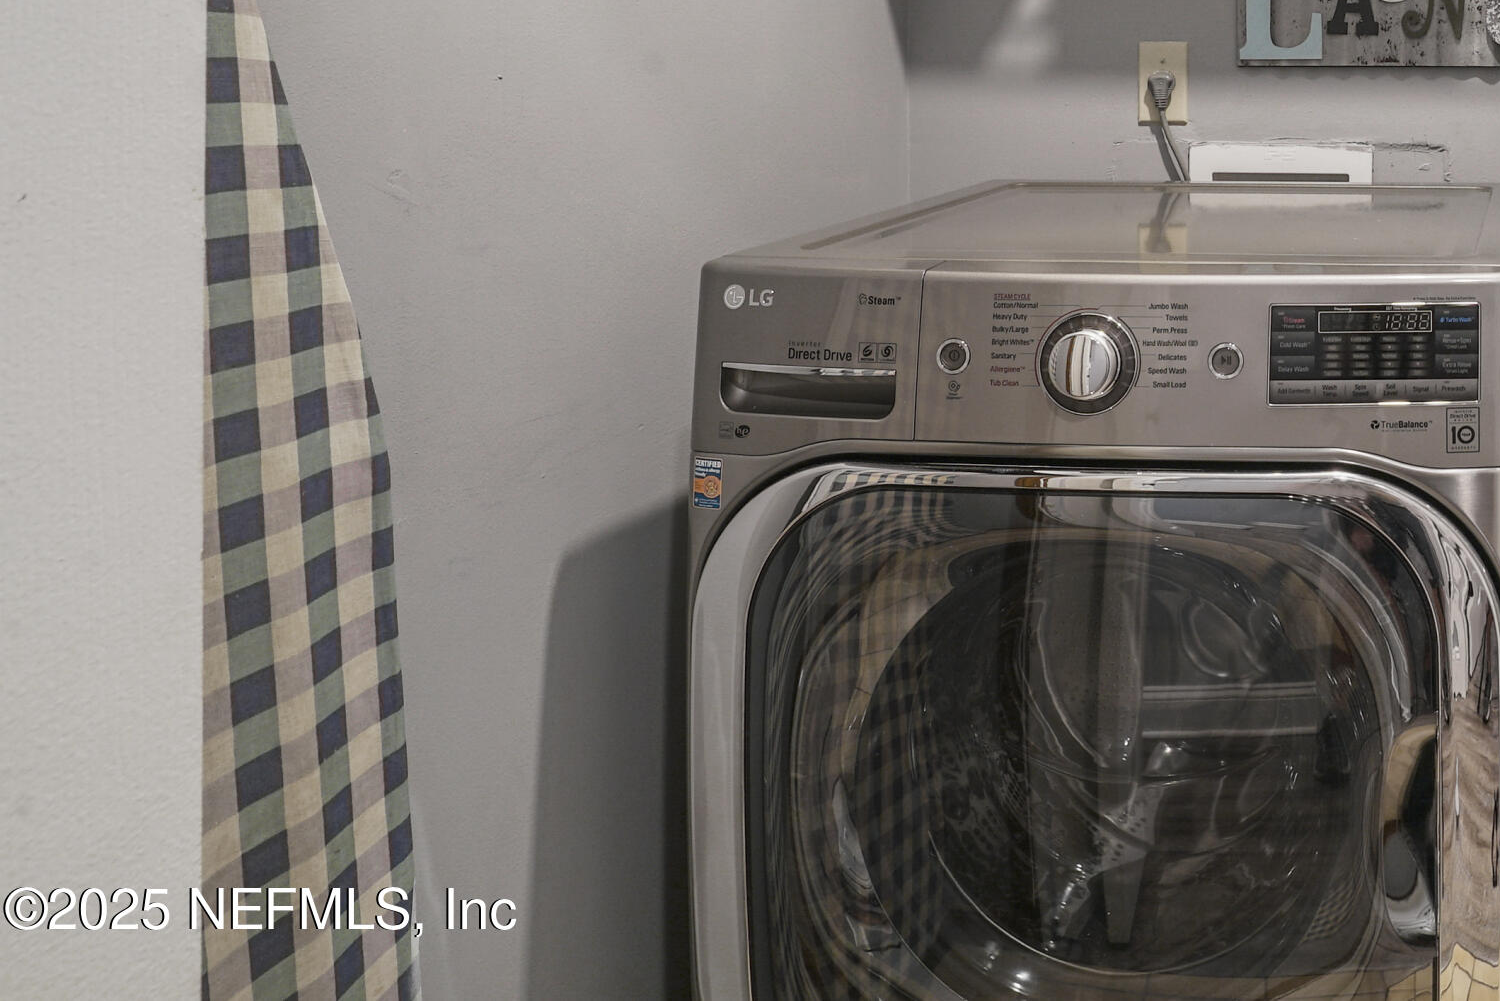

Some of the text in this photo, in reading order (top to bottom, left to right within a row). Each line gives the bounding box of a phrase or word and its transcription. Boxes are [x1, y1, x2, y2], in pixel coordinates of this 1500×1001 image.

[749, 288, 774, 307] LG
[993, 313, 1028, 321] Heavy Duty
[992, 326, 1029, 334] Bulky/Large
[788, 348, 852, 361] Direct Drive
[991, 352, 1016, 360] Sanitary
[1147, 367, 1167, 375] Speed
[1452, 426, 1475, 444] 10
